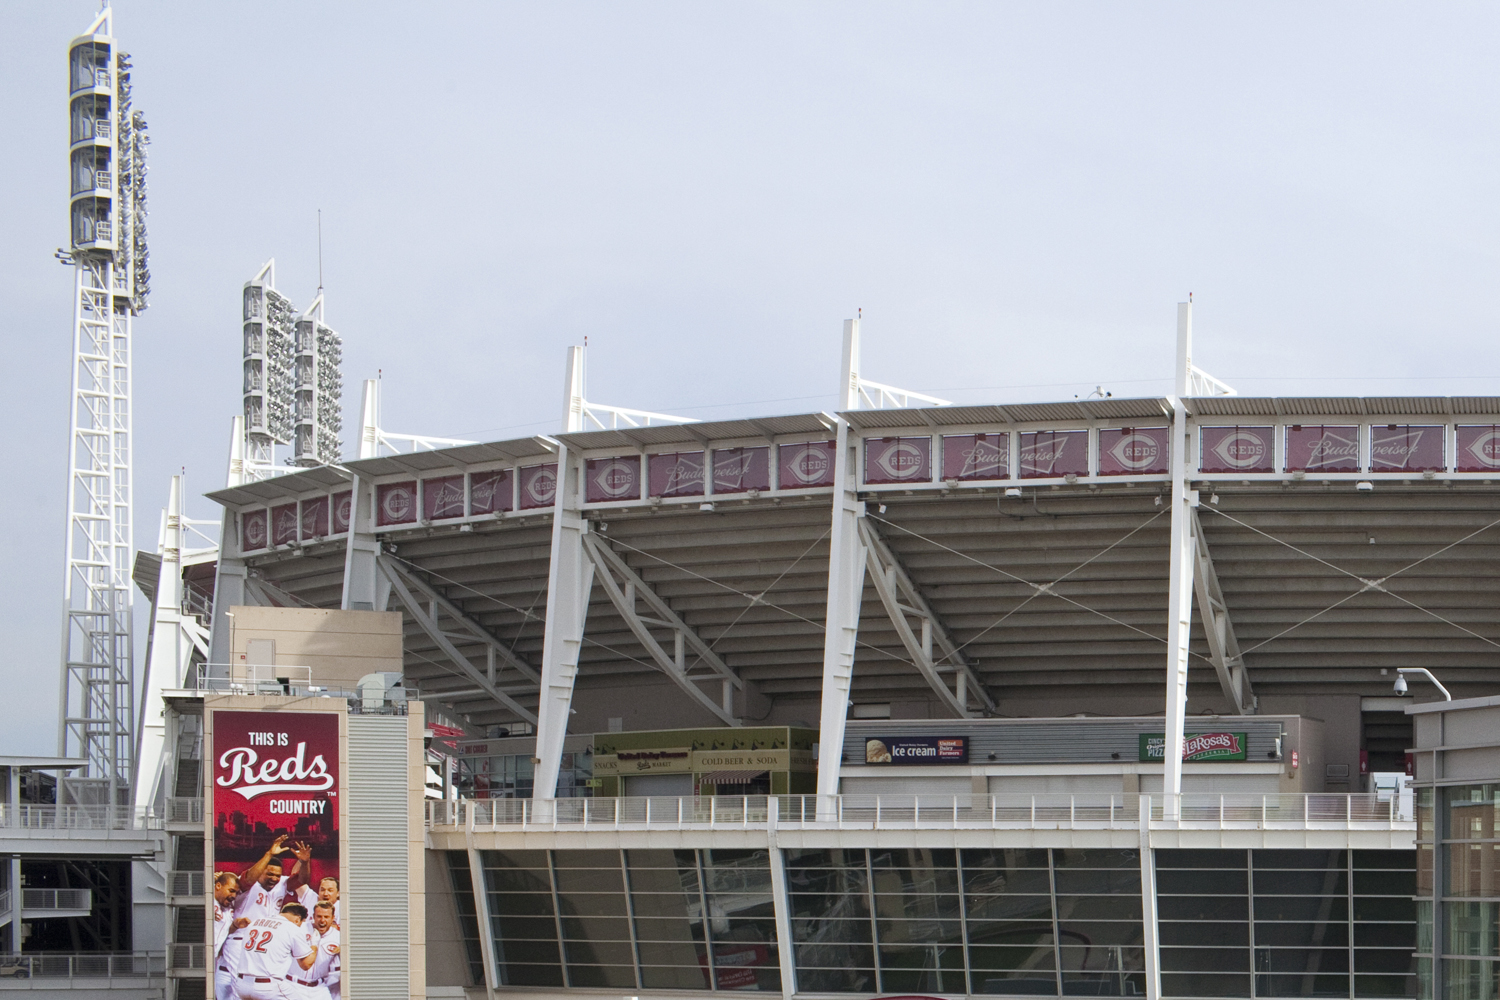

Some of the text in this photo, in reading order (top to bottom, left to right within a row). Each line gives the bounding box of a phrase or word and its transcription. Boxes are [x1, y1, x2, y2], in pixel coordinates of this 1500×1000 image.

[1125, 447, 1157, 457] REDS
[1229, 445, 1263, 455] REDS
[891, 455, 921, 465] REDS
[801, 461, 827, 470] REDS
[607, 474, 632, 484] REDS
[248, 732, 288, 746] THIS IS
[1186, 735, 1230, 754] LaRosa's
[892, 745, 936, 756] Ice cream
[1148, 749, 1165, 757] PIZZ
[702, 757, 778, 766] COLD BEER & SODA
[217, 742, 334, 800] Reds
[270, 800, 326, 814] COUNTRY
[256, 893, 268, 907] 31
[253, 919, 282, 929] BRUCE
[245, 929, 273, 953] 32
